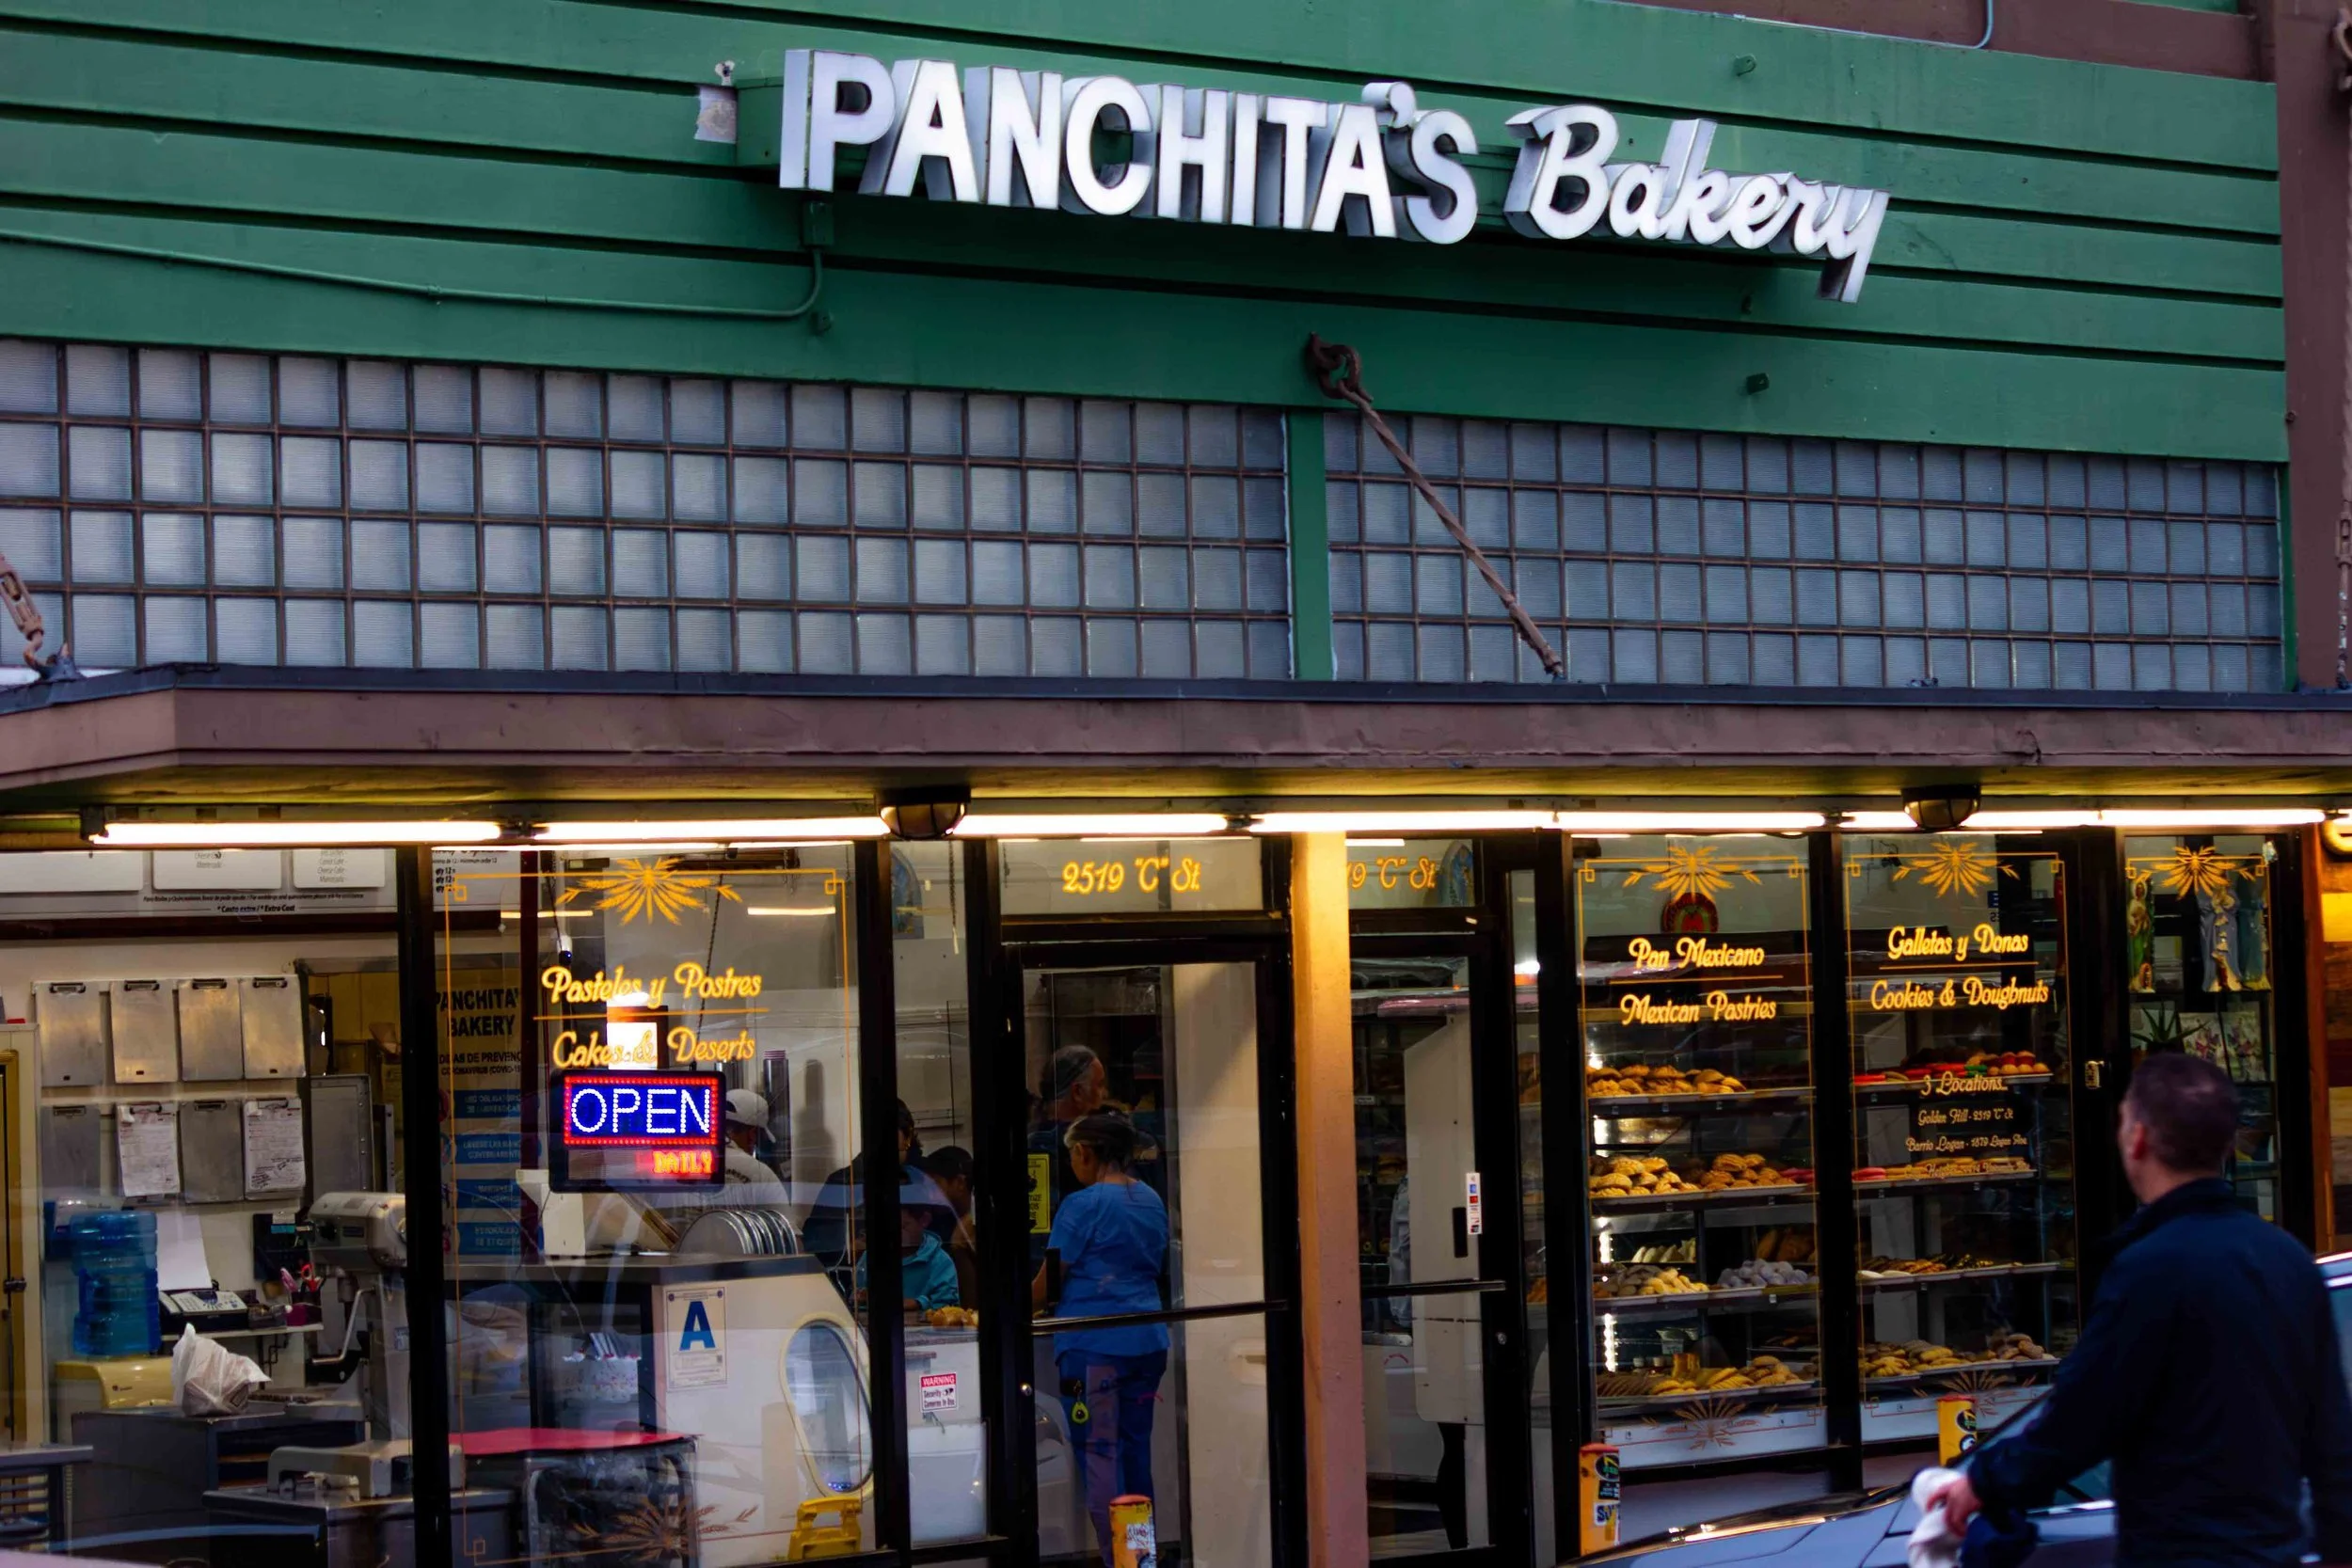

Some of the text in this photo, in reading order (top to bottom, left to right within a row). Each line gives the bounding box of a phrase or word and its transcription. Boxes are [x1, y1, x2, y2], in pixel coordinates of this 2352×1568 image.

[780, 49, 1889, 303] PANCHITA'S Bakery
[1062, 861, 1125, 895] 2519
[1134, 856, 1169, 894] "C"
[1629, 937, 1765, 970] Pan Mexicano
[1887, 923, 2029, 962] Galletas y Donas
[542, 961, 763, 1009] Pasteles y Postres
[1870, 975, 2049, 1011] Cookies & Doughnuts
[447, 1015, 516, 1037] BAKERY
[1620, 990, 1777, 1027] Mexican Pastries
[553, 1025, 756, 1069] Cakes & Deserts
[1919, 1074, 1931, 1096] 3
[570, 1087, 710, 1134] OPEN
[652, 1149, 713, 1174] DAILY
[1935, 1135, 1965, 1153] Logan
[679, 1301, 716, 1351] A
[922, 1375, 955, 1386] WARNING
